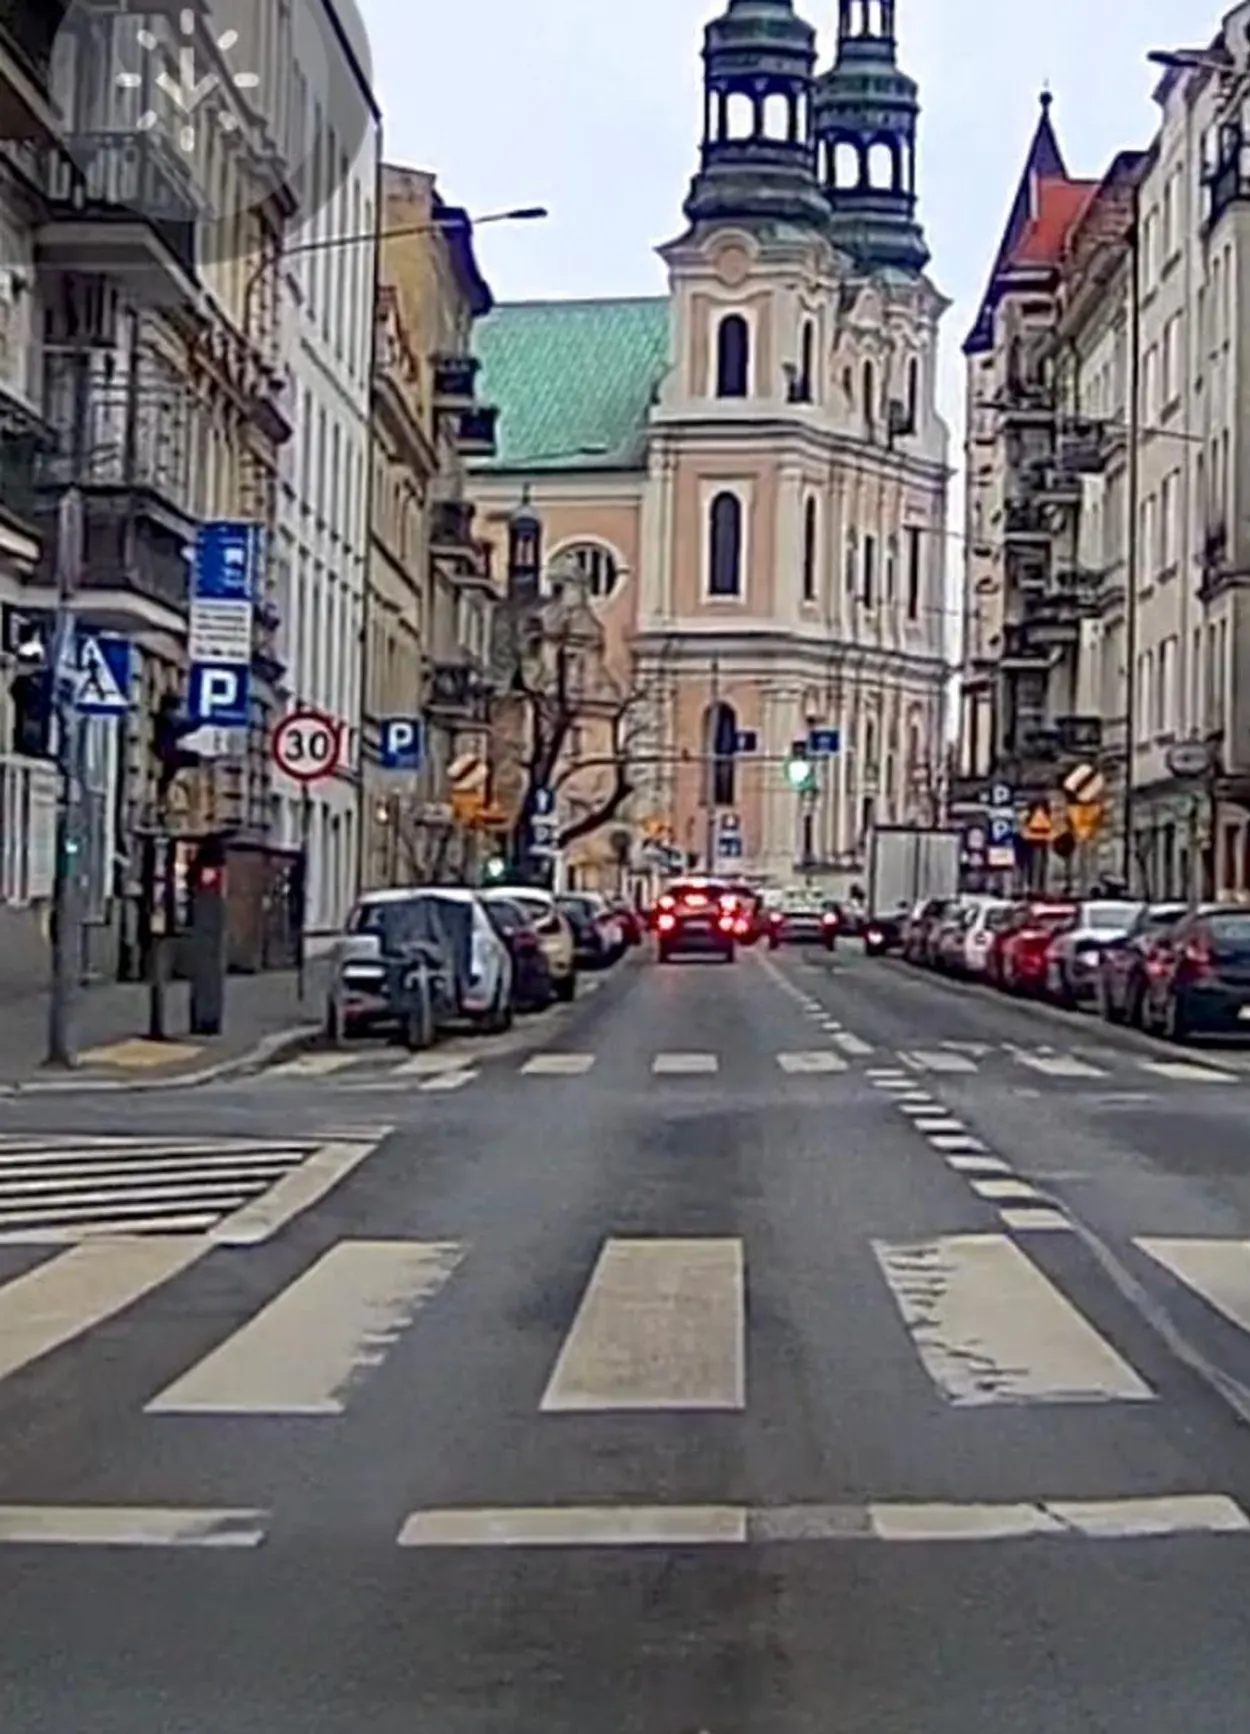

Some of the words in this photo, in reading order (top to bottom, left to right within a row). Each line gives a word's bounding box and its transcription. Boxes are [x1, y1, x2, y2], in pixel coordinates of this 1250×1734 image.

[200, 668, 238, 718] P
[284, 728, 330, 762] 30
[388, 722, 414, 753] P
